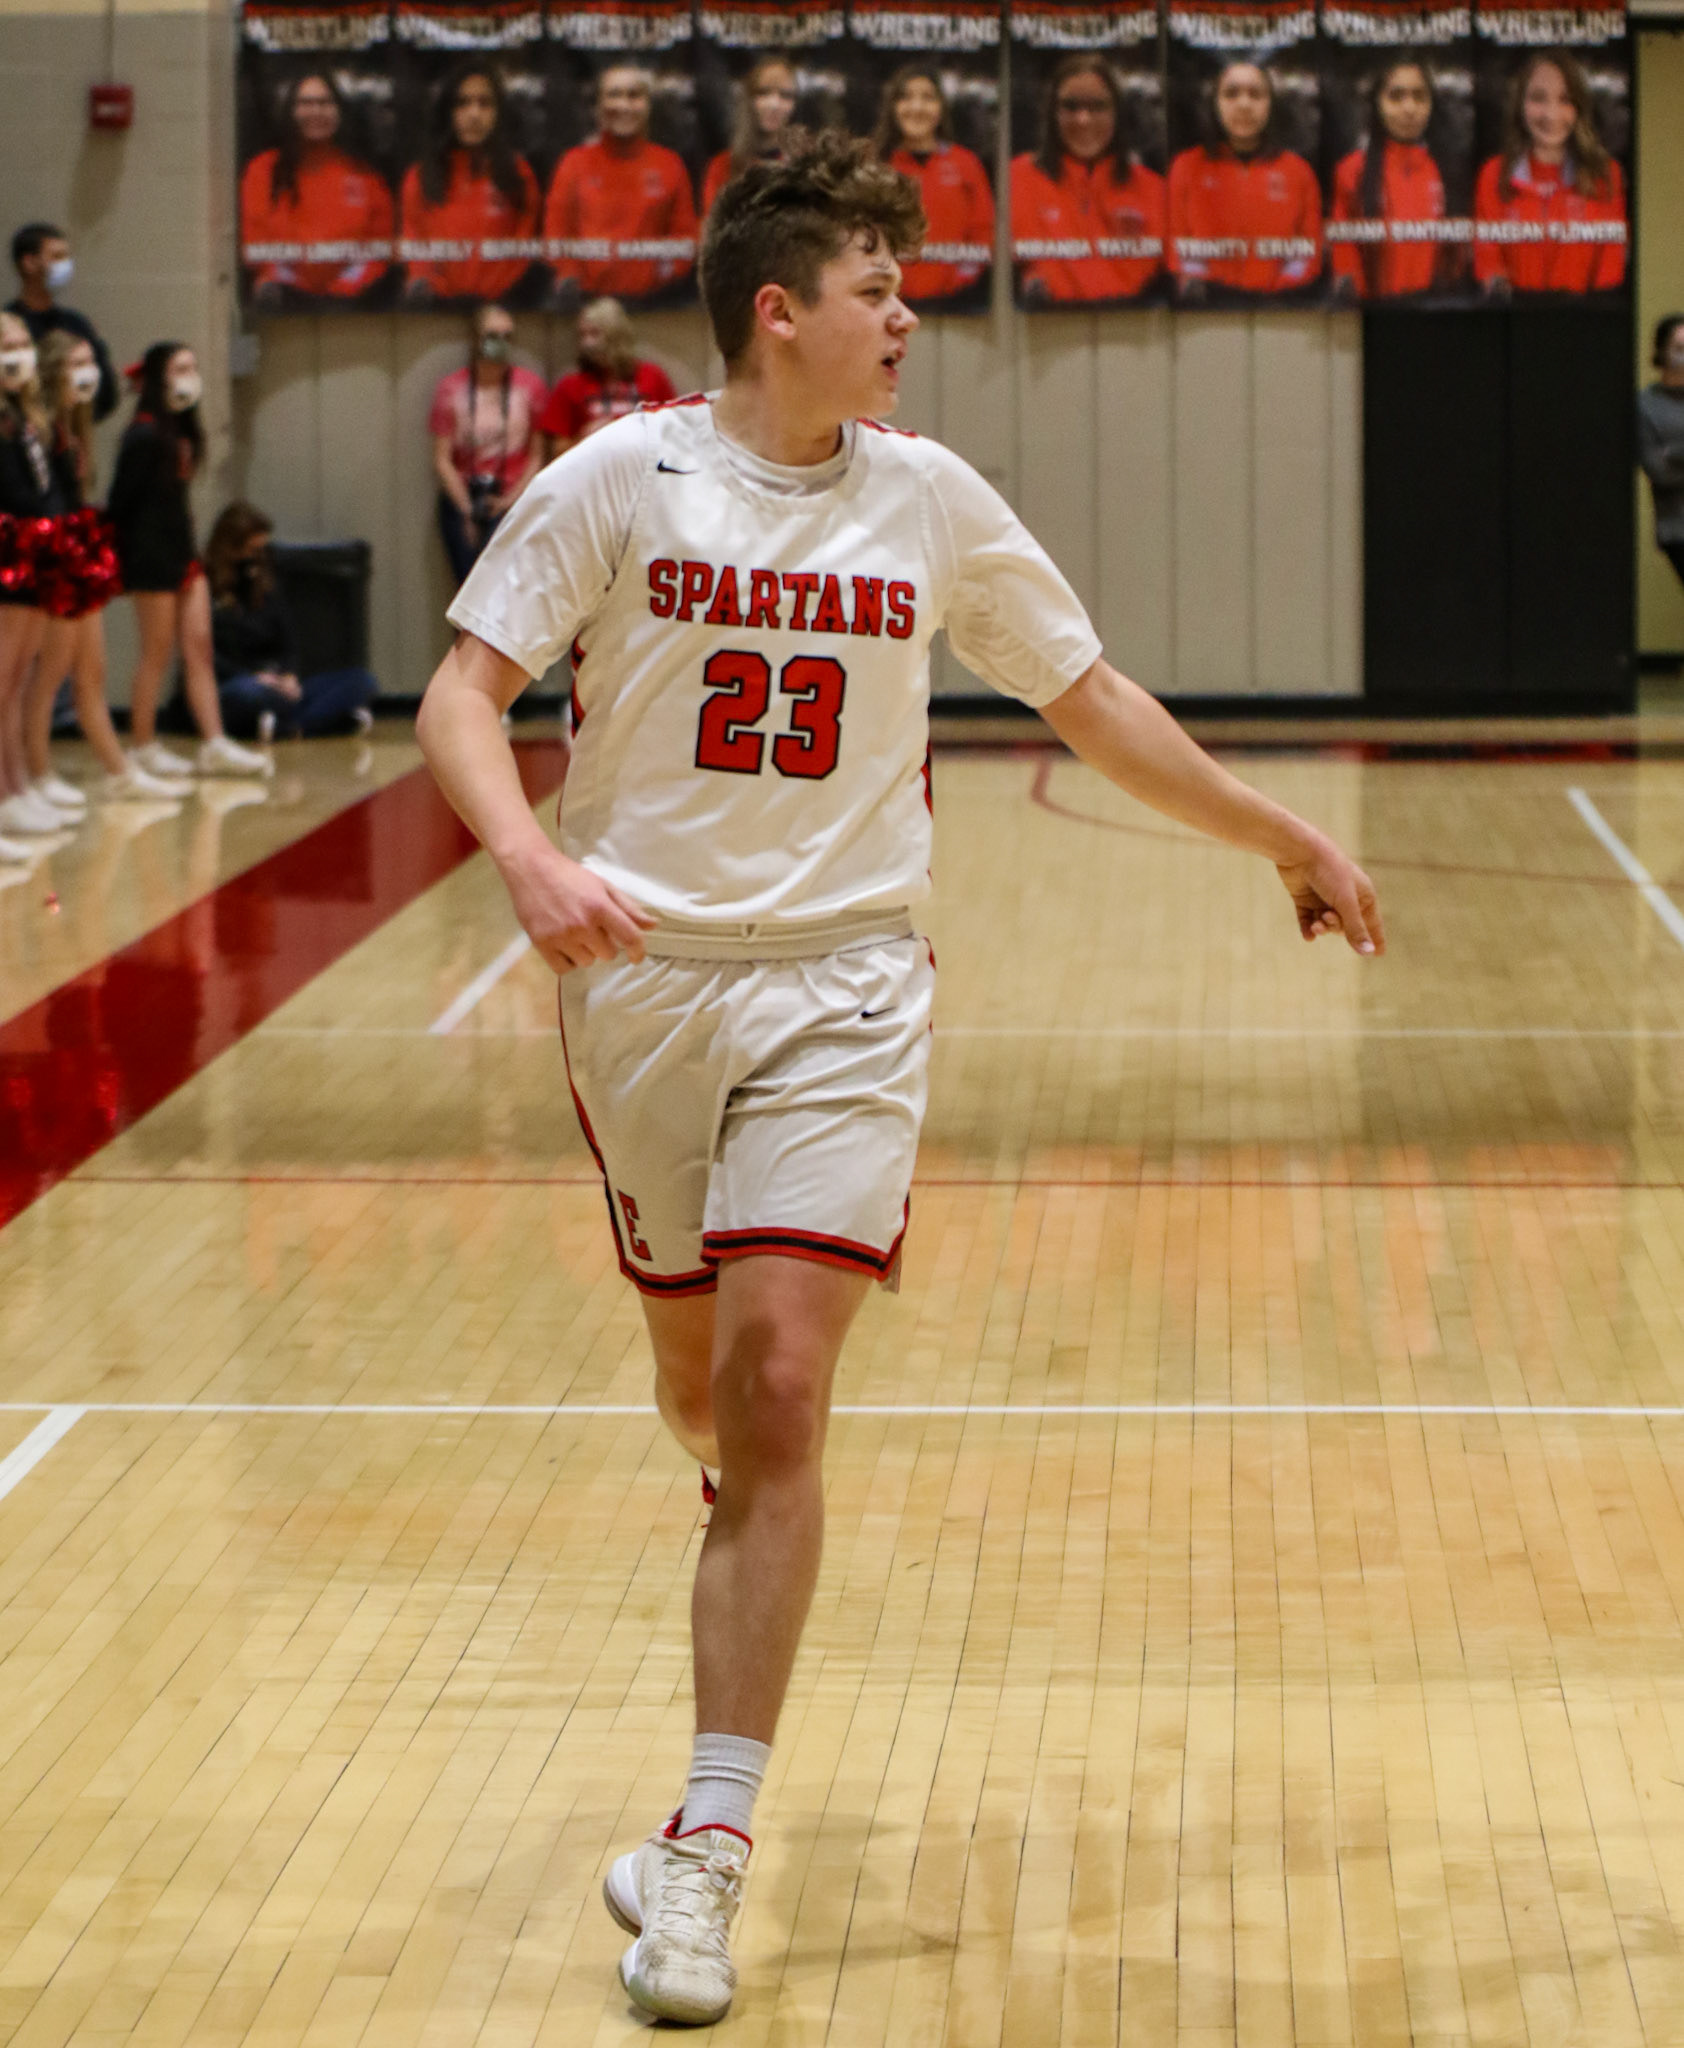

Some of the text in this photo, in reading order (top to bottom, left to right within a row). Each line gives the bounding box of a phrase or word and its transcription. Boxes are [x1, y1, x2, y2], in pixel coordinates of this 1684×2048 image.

[548, 12, 693, 43] WRESTLING
[851, 13, 1000, 44] WRESTLING
[1010, 10, 1157, 41] WRESTLING
[1168, 10, 1315, 42] WRESTLING
[1321, 8, 1470, 39] WRESTLING
[1475, 8, 1625, 40] WRESTLING
[1549, 220, 1627, 243] FLOWERS
[1097, 237, 1163, 259] TAYLOR
[1176, 237, 1316, 259] TRINITY ERVIN
[648, 558, 916, 640] SPARTANS
[695, 649, 847, 780] 23
[617, 1188, 653, 1262] E
